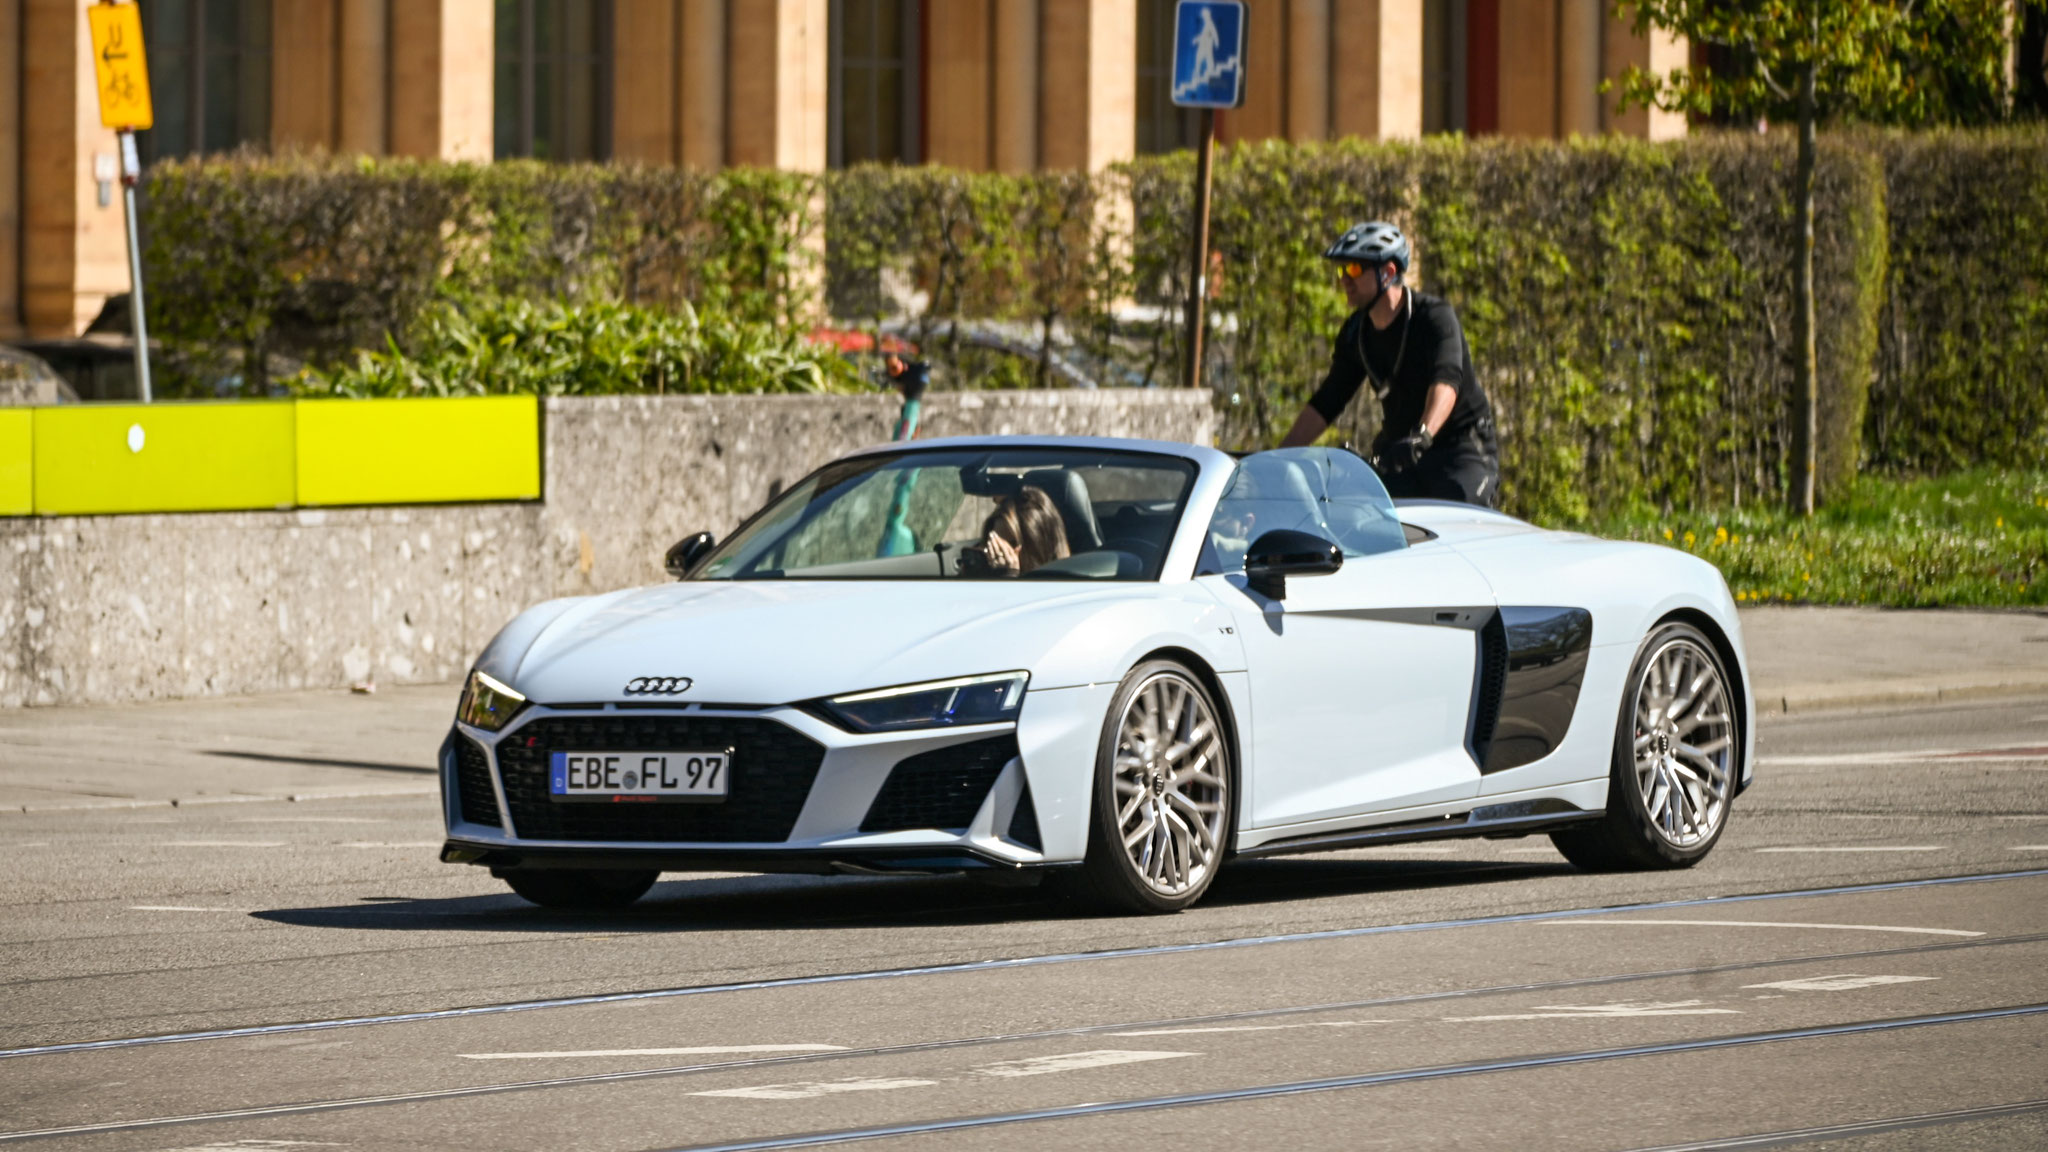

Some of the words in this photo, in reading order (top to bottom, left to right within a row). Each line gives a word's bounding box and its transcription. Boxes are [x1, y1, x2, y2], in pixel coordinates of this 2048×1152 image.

[568, 757, 620, 789] EBE
[640, 757, 678, 789] FL
[686, 757, 722, 789] 97
